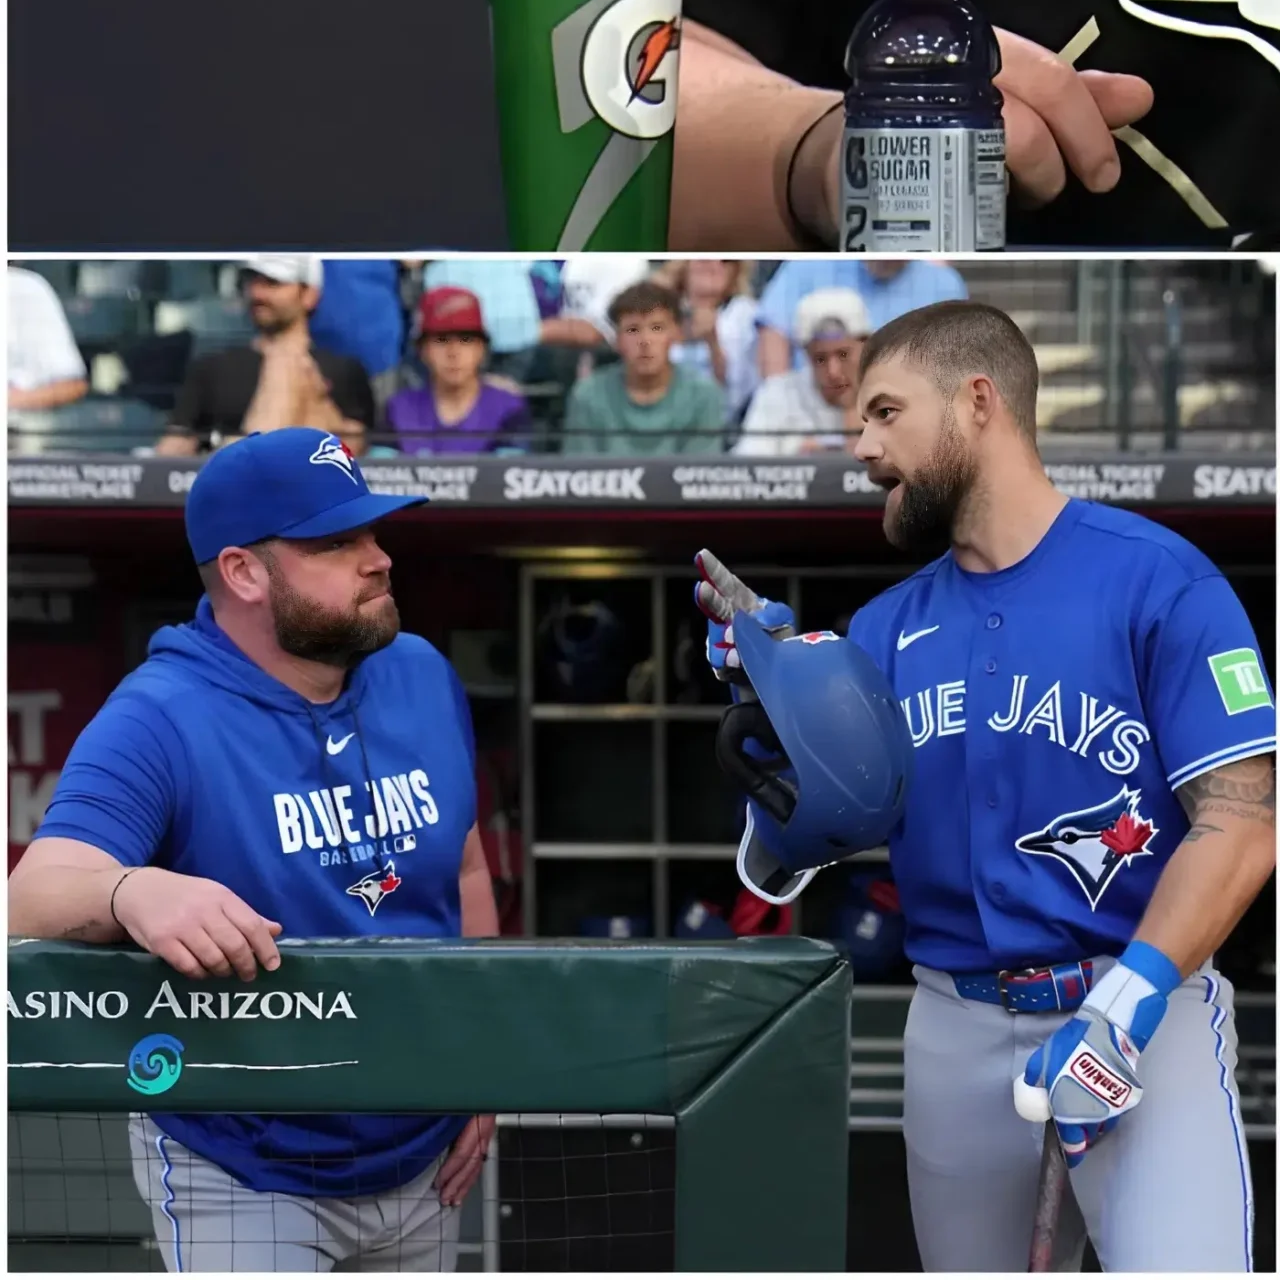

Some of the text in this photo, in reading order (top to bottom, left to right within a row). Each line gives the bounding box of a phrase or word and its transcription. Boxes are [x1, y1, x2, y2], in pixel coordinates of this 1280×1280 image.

[869, 136, 930, 157] LOWER
[869, 159, 930, 181] SUGAR
[503, 467, 646, 500] SEATGEEK
[672, 466, 752, 484] OFFICIAL
[900, 674, 1151, 776] UE JAYS
[273, 769, 440, 854] BLUE JAYS
[7, 990, 129, 1019] ASINO
[1078, 1058, 1128, 1101] Franklin
